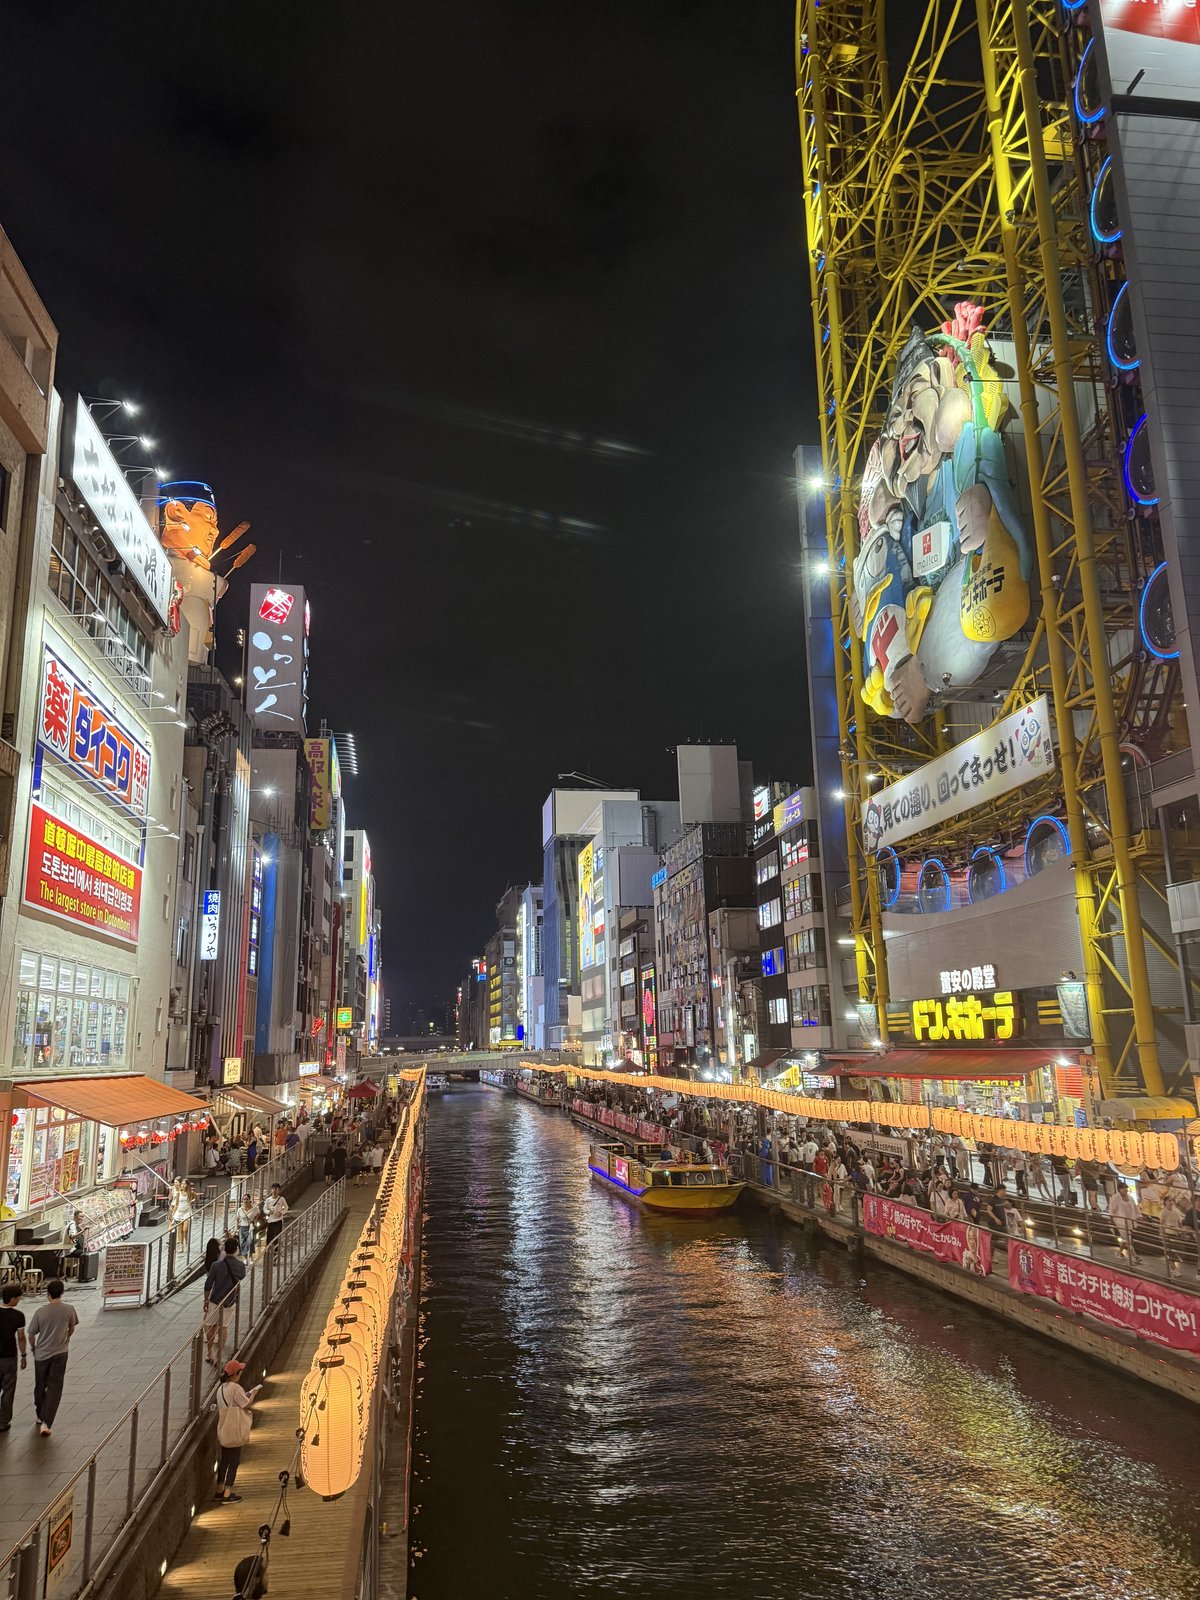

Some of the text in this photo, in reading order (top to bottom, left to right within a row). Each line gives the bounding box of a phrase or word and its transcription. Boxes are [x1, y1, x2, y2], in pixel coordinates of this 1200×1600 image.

[252, 631, 297, 721] いっとく
[44, 660, 70, 750] 薬
[74, 702, 131, 793] ダイコク
[134, 748, 147, 789] 免税
[41, 851, 93, 896] 도톤보리에서
[40, 879, 54, 902] The
[55, 886, 79, 913] largest
[80, 900, 97, 919] store
[97, 905, 104, 922] in
[208, 893, 219, 914] 焼肉
[206, 916, 217, 958] いろりや
[940, 964, 996, 994] 驚安の殿堂
[1057, 1262, 1197, 1337] 話にオチは絶対つけてや!
